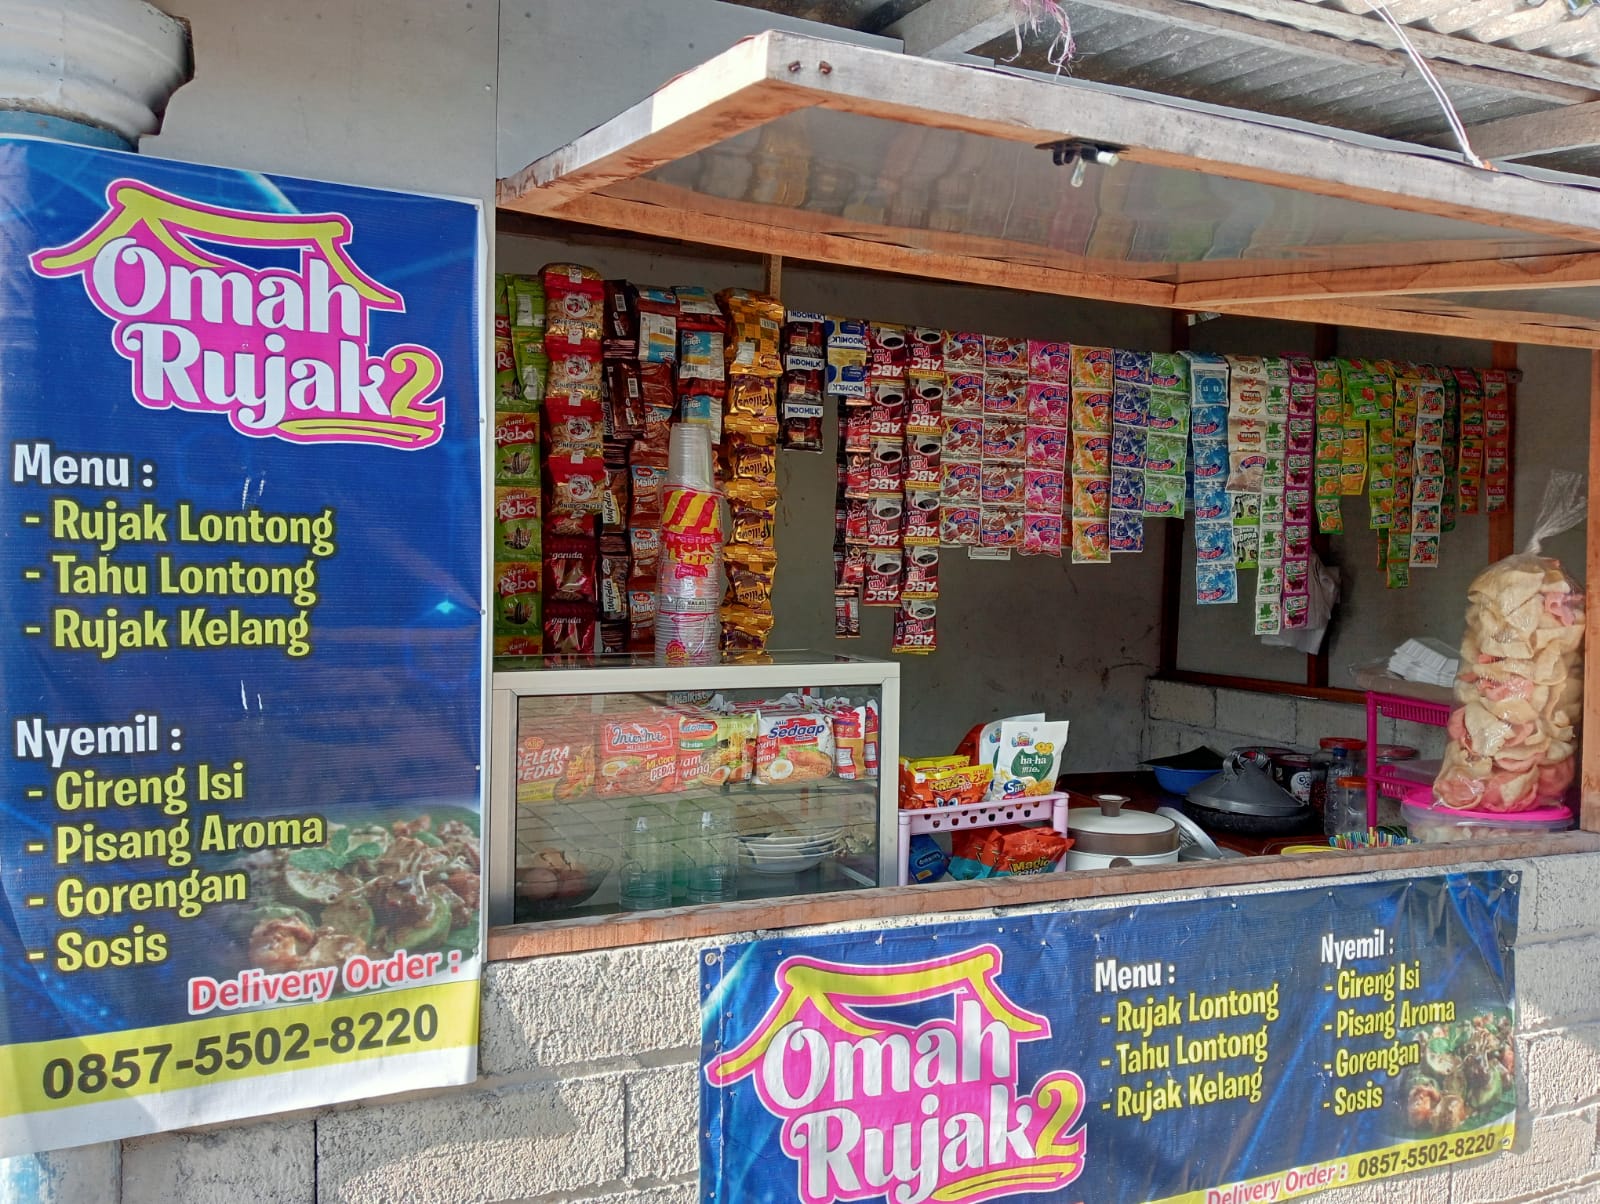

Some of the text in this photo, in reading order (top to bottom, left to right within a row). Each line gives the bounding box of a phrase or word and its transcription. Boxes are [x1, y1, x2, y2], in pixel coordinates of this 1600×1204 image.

[93, 237, 361, 337] Omah
[122, 322, 391, 430] Rujak
[790, 359, 821, 369] INDOMILK
[871, 364, 903, 377] ABC
[912, 358, 942, 371] ABC
[738, 394, 769, 406] Pillows
[788, 407, 821, 416] INDOMILK
[496, 425, 535, 443] Rebo
[869, 422, 901, 434] ABC
[910, 414, 940, 428] ABC
[14, 443, 129, 488] Menu
[738, 462, 769, 475] Pillows
[909, 470, 939, 482] ABC
[868, 478, 900, 490] ABC
[499, 500, 536, 519] Rebo
[605, 491, 614, 522] Wafello
[54, 499, 167, 551] Rujak
[180, 504, 335, 557] Lontong
[867, 535, 900, 546] ABC
[907, 525, 937, 537] ABC
[53, 555, 147, 594] Tahu
[160, 557, 317, 607] Lontong
[500, 572, 536, 595] Rebo
[605, 580, 614, 610] Wafello
[865, 590, 899, 601] ABC
[905, 580, 936, 592] ABC
[54, 608, 168, 659] Rujak
[181, 608, 310, 657] Kelang
[904, 634, 934, 645] ABC
[16, 714, 158, 768] Nyemil
[768, 724, 825, 739] Sedaap
[56, 767, 188, 815] Cireng
[199, 761, 243, 801] Isi
[57, 818, 192, 867] Pisang
[201, 814, 323, 851] Aroma
[57, 869, 247, 918] Gorengan
[57, 924, 169, 972] Sosis
[1321, 929, 1384, 969] Nyemil
[191, 967, 334, 1012] Delivery
[346, 953, 442, 987] Order
[1095, 960, 1162, 993] Menu
[1338, 966, 1394, 1001] Cireng
[1400, 961, 1420, 990] Isi
[1117, 994, 1181, 1038] Rujak
[1189, 984, 1279, 1021] Lontong
[1337, 1004, 1395, 1039] Pisang
[1400, 1001, 1455, 1028] Aroma
[43, 1003, 439, 1100] 0857-5502-8220
[762, 1000, 1010, 1109] Omah
[1117, 1040, 1169, 1075] Tahu
[1177, 1026, 1268, 1064] Lontong
[1336, 1041, 1419, 1076] Gorengan
[1117, 1079, 1182, 1121] Rujak
[1190, 1066, 1262, 1107] Kelang
[1335, 1081, 1383, 1115] Sosis
[790, 1085, 1037, 1204] Rujak
[1358, 1132, 1495, 1179] 0857-5502-8220
[1207, 1180, 1281, 1204] Delivery
[1286, 1167, 1335, 1191] Order
